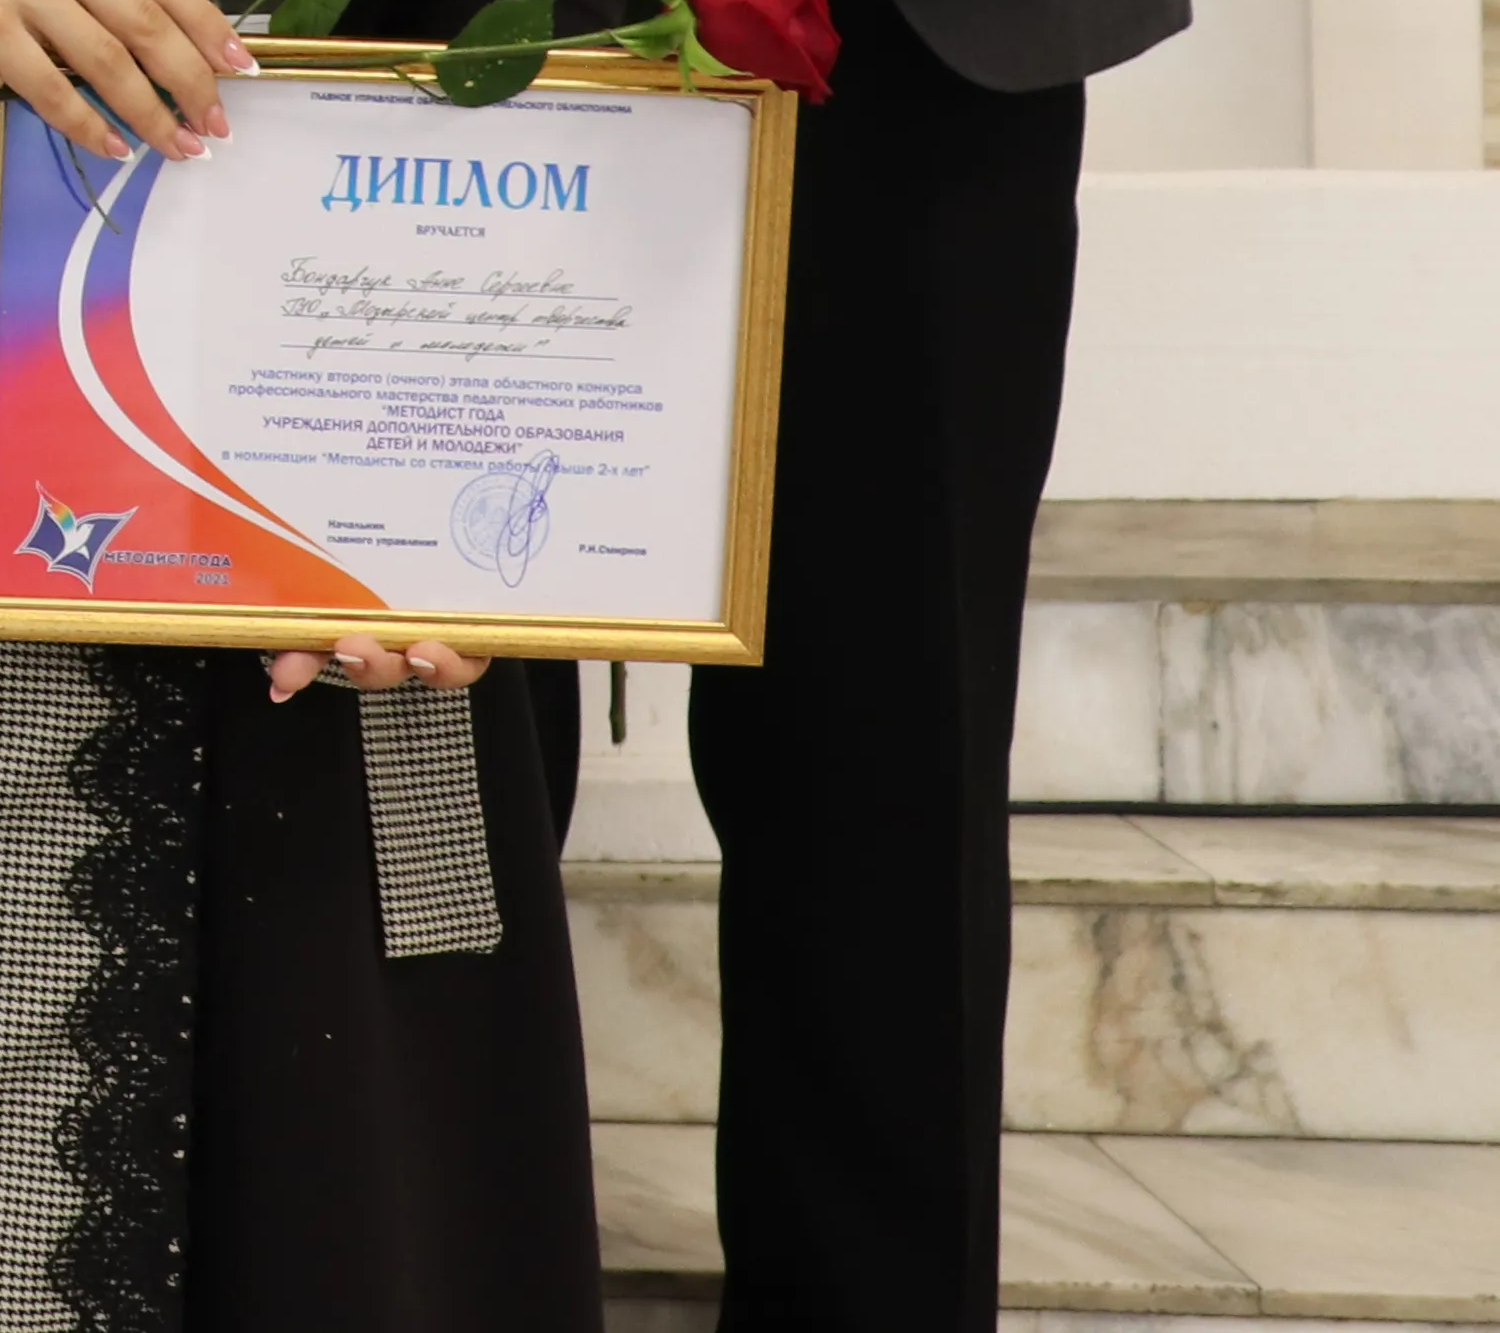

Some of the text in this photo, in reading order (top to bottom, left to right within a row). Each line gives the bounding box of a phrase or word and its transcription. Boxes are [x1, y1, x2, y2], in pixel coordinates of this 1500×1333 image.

[320, 153, 590, 219] ДИПЛОМ
[415, 224, 485, 237] ВРУЧАЕТСЯ
[250, 368, 642, 396] участнику второго (очного) этапа областного конкурса
[228, 383, 663, 412] профессионального мастерства педагогических работников
[468, 408, 505, 421] ГОДА
[262, 416, 624, 442] УЧРЕЖДЕНИЯ ДОПОЛНИТЕЛЬНОГО ОБРАЗОВАНИЯ
[366, 435, 412, 451] ДЕТЕЙ
[416, 438, 427, 450] И
[221, 450, 230, 460] в
[234, 450, 316, 464] номинации
[410, 458, 426, 467] со
[430, 458, 483, 470] стажем
[104, 550, 232, 567] МЕТОДИСТ ГОДА
